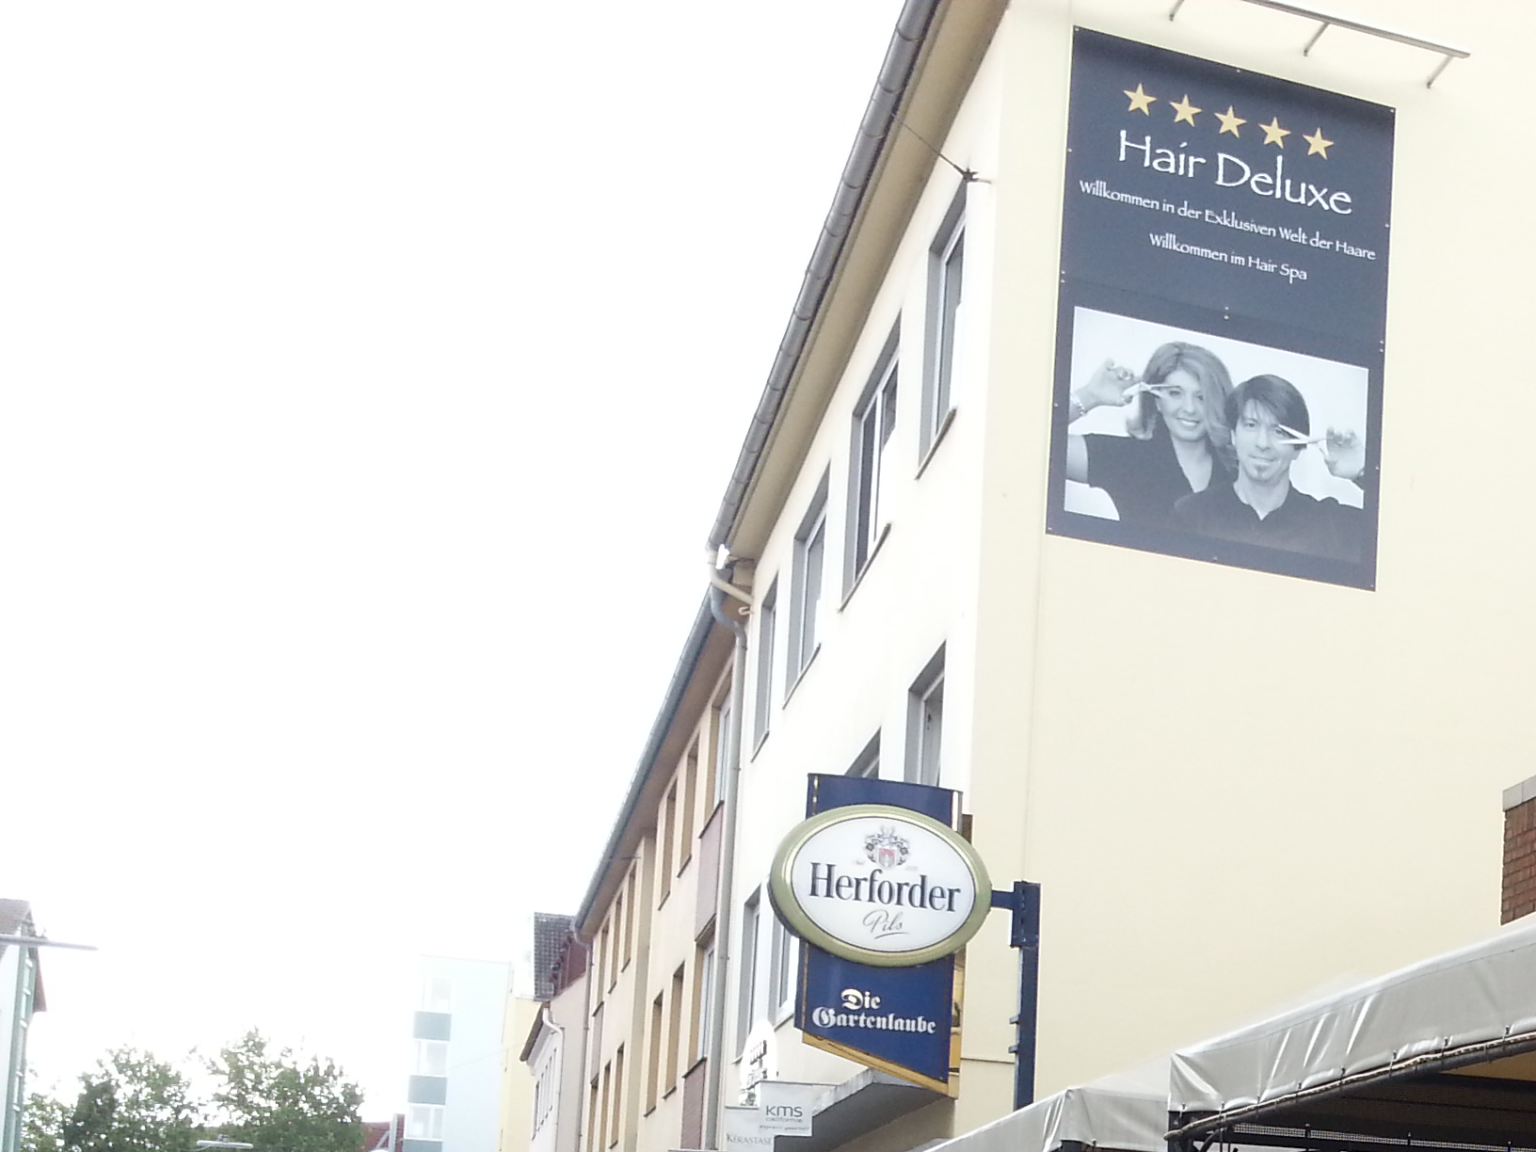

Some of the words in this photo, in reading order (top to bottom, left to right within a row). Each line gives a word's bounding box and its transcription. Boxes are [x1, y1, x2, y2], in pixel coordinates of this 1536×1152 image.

[1118, 129, 1207, 178] Hair
[1214, 152, 1353, 215] Deluxe
[1079, 180, 1160, 210] Willkommen
[1162, 198, 1175, 214] in
[1177, 201, 1202, 219] der
[1204, 209, 1277, 238] Exklusiven
[1279, 226, 1308, 245] Welt
[1309, 231, 1334, 250] der
[1336, 240, 1377, 260] Haare
[1149, 232, 1228, 262] Willkommen
[1230, 250, 1246, 266] im
[1248, 256, 1278, 273] Hair
[1279, 263, 1308, 284] Spa
[809, 861, 962, 913] Herforder
[862, 908, 905, 934] Pils
[841, 988, 882, 1011] Die
[812, 1006, 937, 1034] Gartenlaube
[766, 1105, 803, 1118] kms
